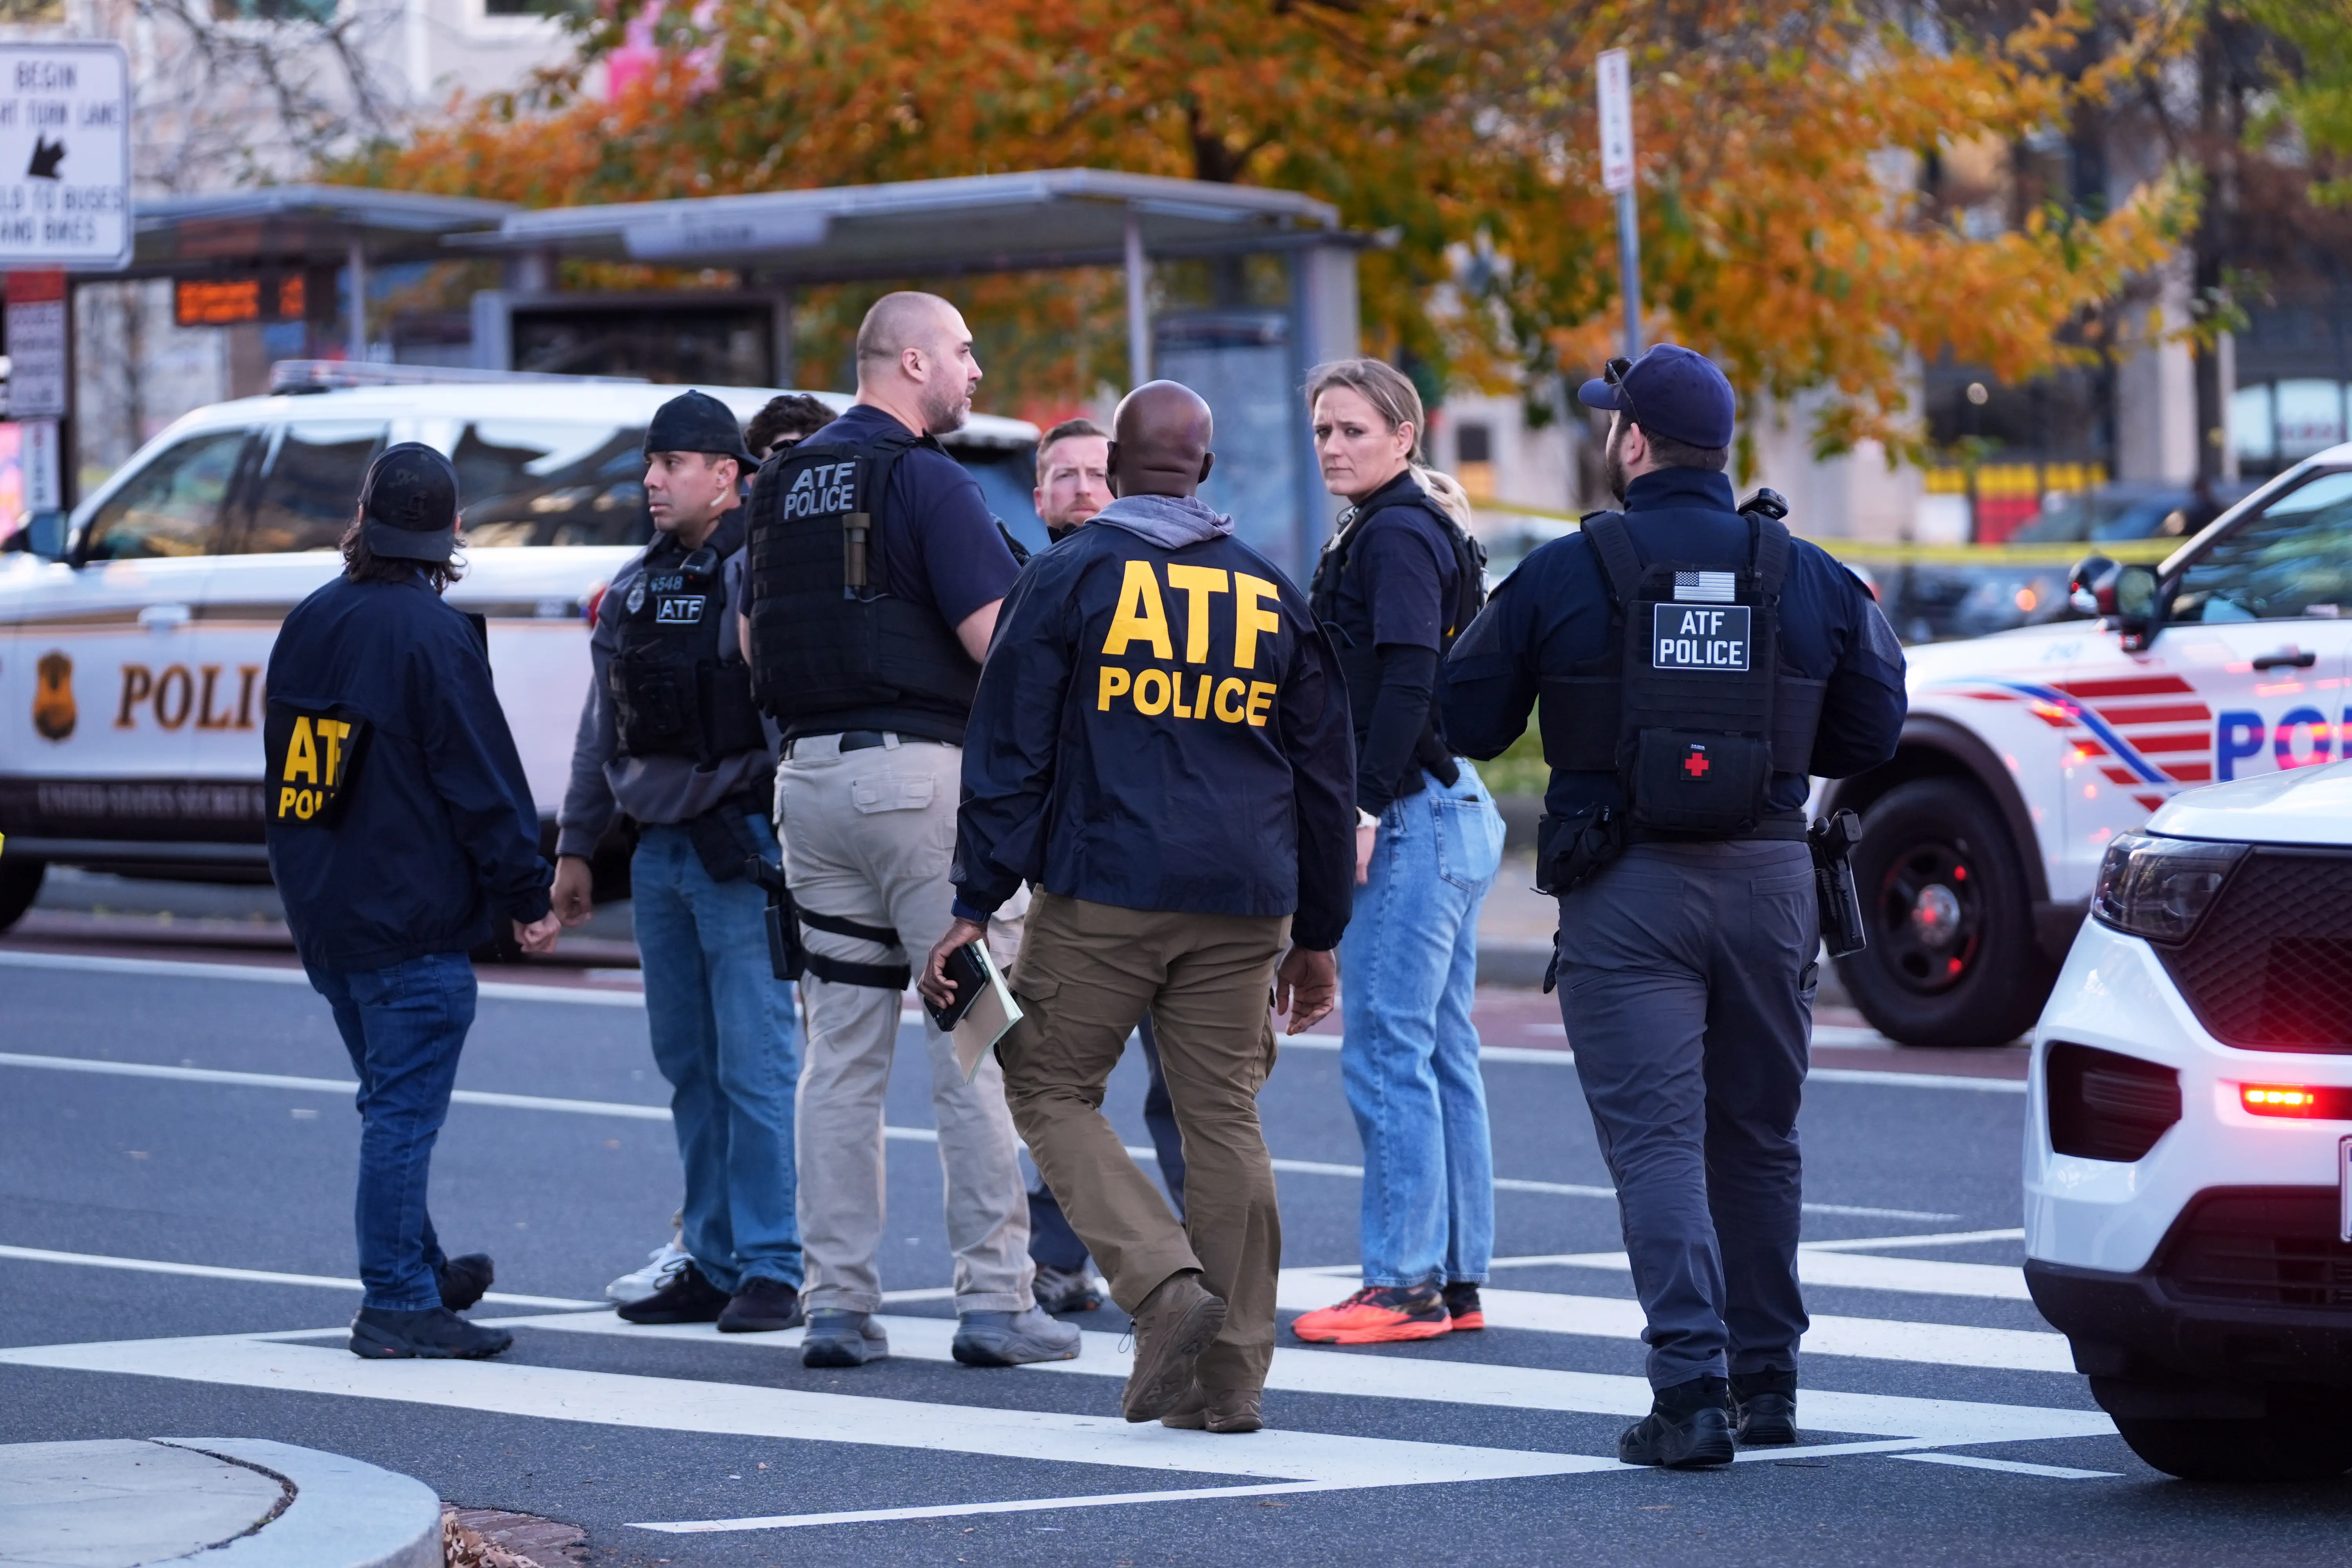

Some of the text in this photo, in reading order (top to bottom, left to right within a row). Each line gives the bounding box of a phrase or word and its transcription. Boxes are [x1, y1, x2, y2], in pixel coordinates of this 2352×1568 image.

[15, 61, 77, 90] BEGIN
[27, 99, 69, 127] TURN
[34, 186, 56, 211] TO
[64, 185, 125, 211] BUSES
[44, 216, 96, 244] BIKES
[791, 462, 856, 492] ATF
[784, 484, 854, 520] POLICE
[660, 599, 702, 619] ATF
[1101, 560, 1281, 669] ATF
[1680, 610, 1725, 635] ATF
[1660, 639, 1743, 665] POLICE
[113, 662, 267, 732] POLI
[1098, 666, 1277, 726] POLICE
[2219, 707, 2352, 781] PO
